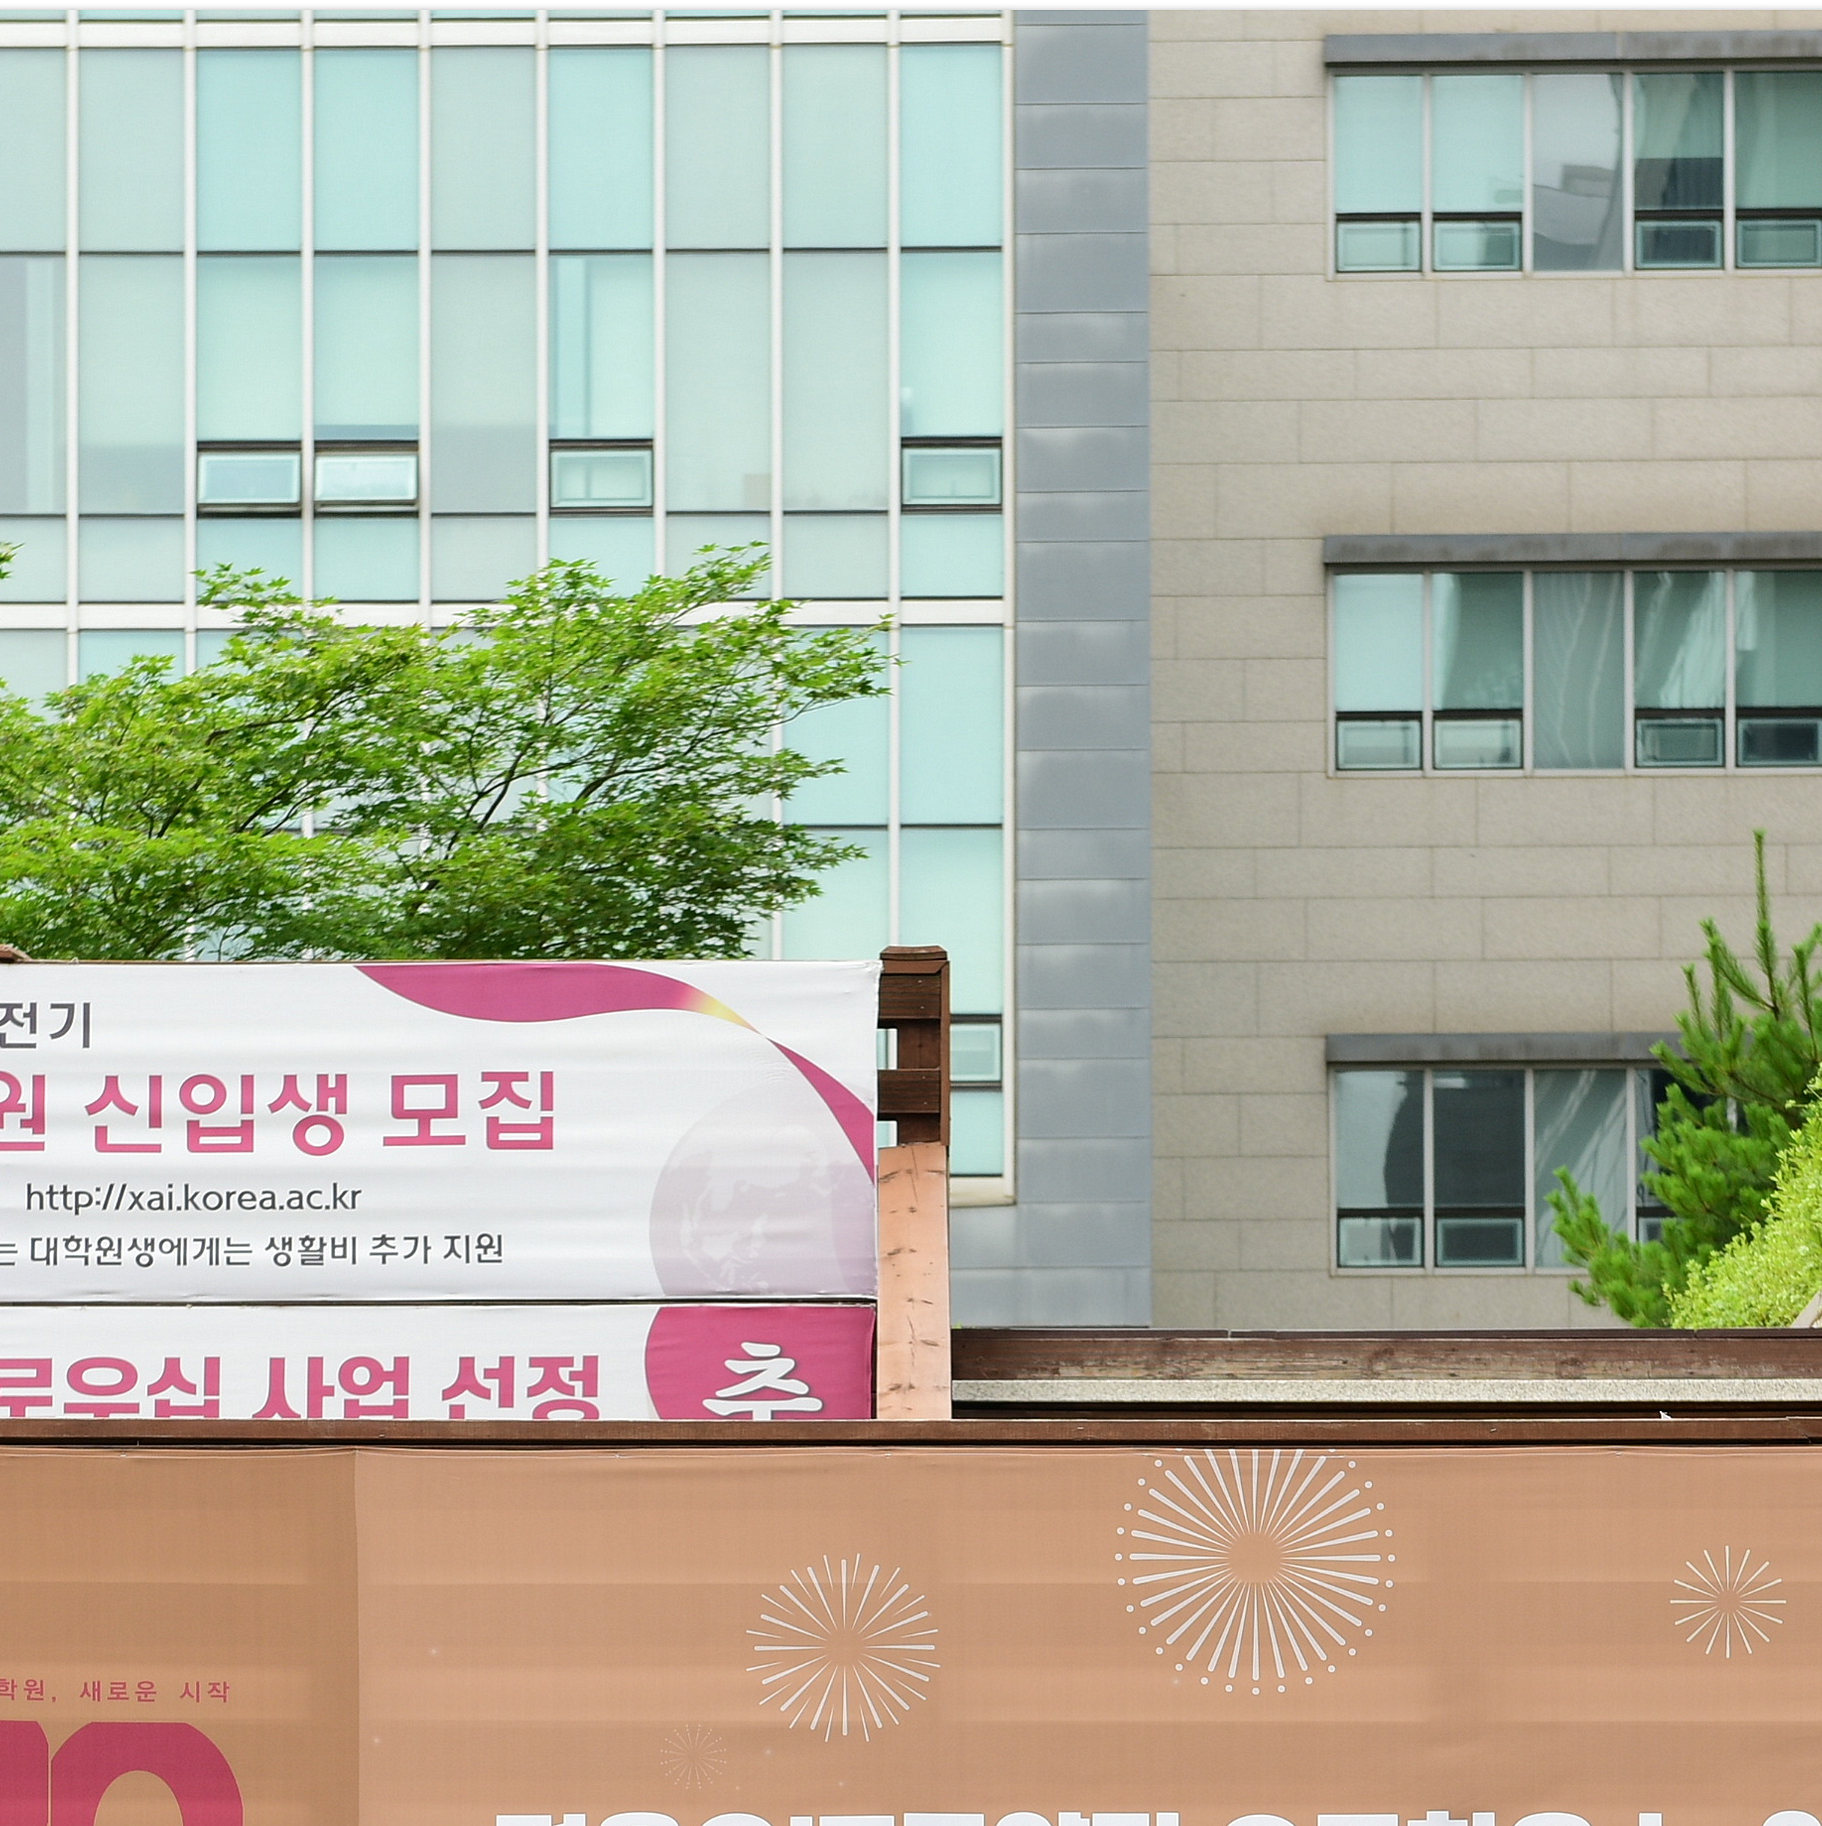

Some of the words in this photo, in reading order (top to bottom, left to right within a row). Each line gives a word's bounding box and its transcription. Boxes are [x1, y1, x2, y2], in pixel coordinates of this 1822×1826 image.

[84, 1073, 348, 1157] 신입생
[382, 1070, 554, 1151] 모집
[26, 1182, 362, 1216] http://xai.korea.ac.kr
[30, 1235, 253, 1268] 대학원생에게는
[265, 1234, 357, 1267] 생활비
[369, 1234, 432, 1265] 추가
[443, 1233, 503, 1264] 지원
[252, 1356, 410, 1419] 사업
[441, 1355, 600, 1419] 선정
[703, 1342, 822, 1419] 추
[79, 1680, 157, 1703] 새로운
[179, 1681, 231, 1704] 시작
